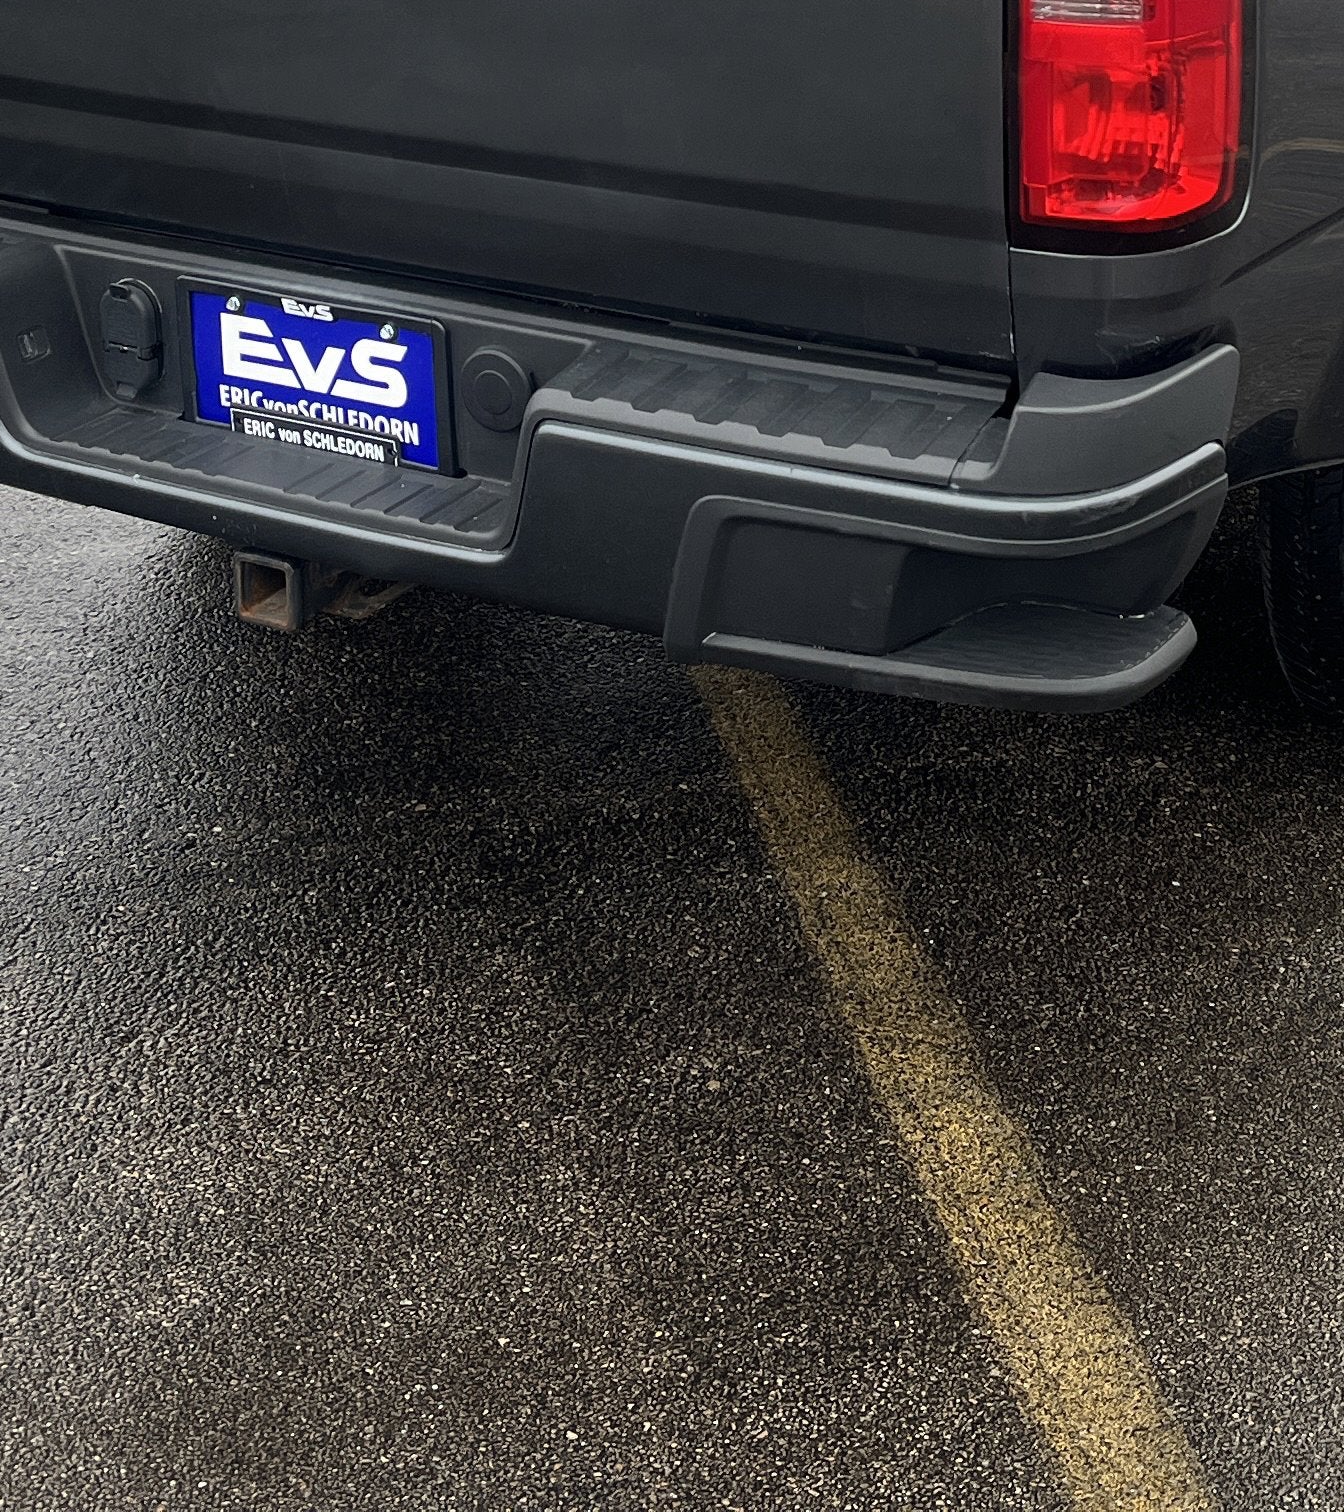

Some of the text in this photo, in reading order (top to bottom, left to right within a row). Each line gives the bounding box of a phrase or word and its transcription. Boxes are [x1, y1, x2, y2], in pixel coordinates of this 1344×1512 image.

[243, 417, 385, 462] ERIC von SCHLEDORN
